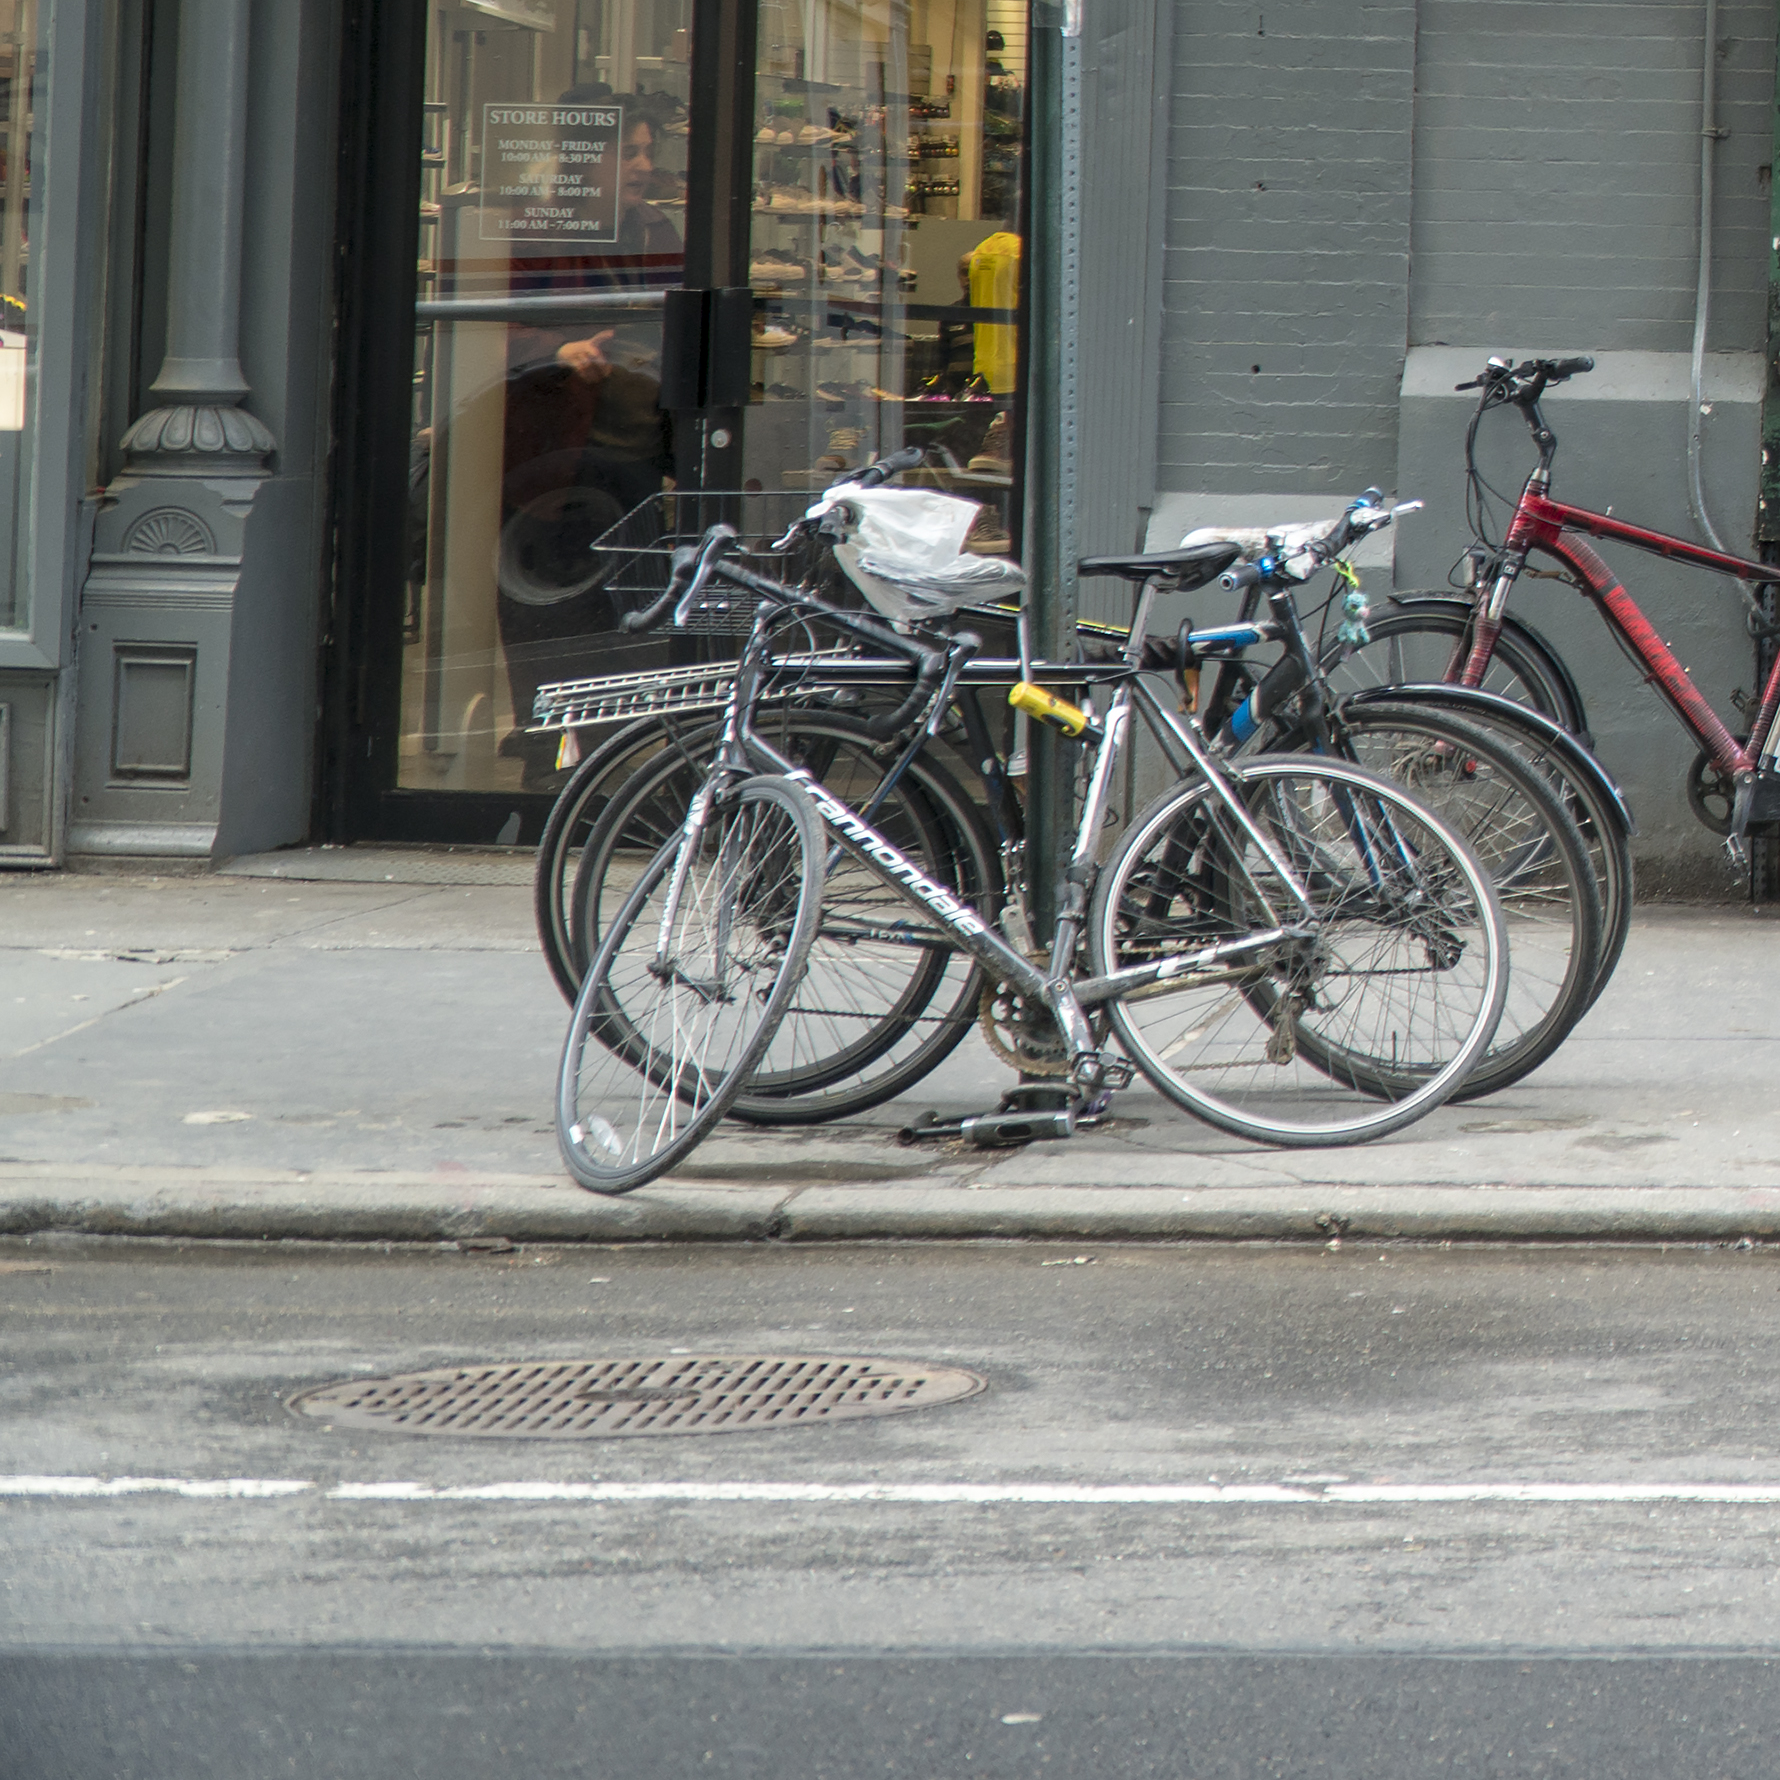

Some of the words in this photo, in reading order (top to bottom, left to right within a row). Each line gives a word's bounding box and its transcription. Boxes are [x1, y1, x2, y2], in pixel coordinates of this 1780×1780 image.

[490, 110, 548, 124] STORE
[551, 111, 616, 126] HOURS
[498, 139, 554, 150] MONDAY
[561, 141, 607, 151] FRIDAY
[531, 153, 551, 162] AM
[582, 154, 602, 164] PM
[519, 174, 584, 185] SATURDAY
[582, 187, 601, 197] PM
[524, 207, 575, 218] SUNDAY
[528, 220, 547, 229] AM
[580, 220, 600, 231] PM
